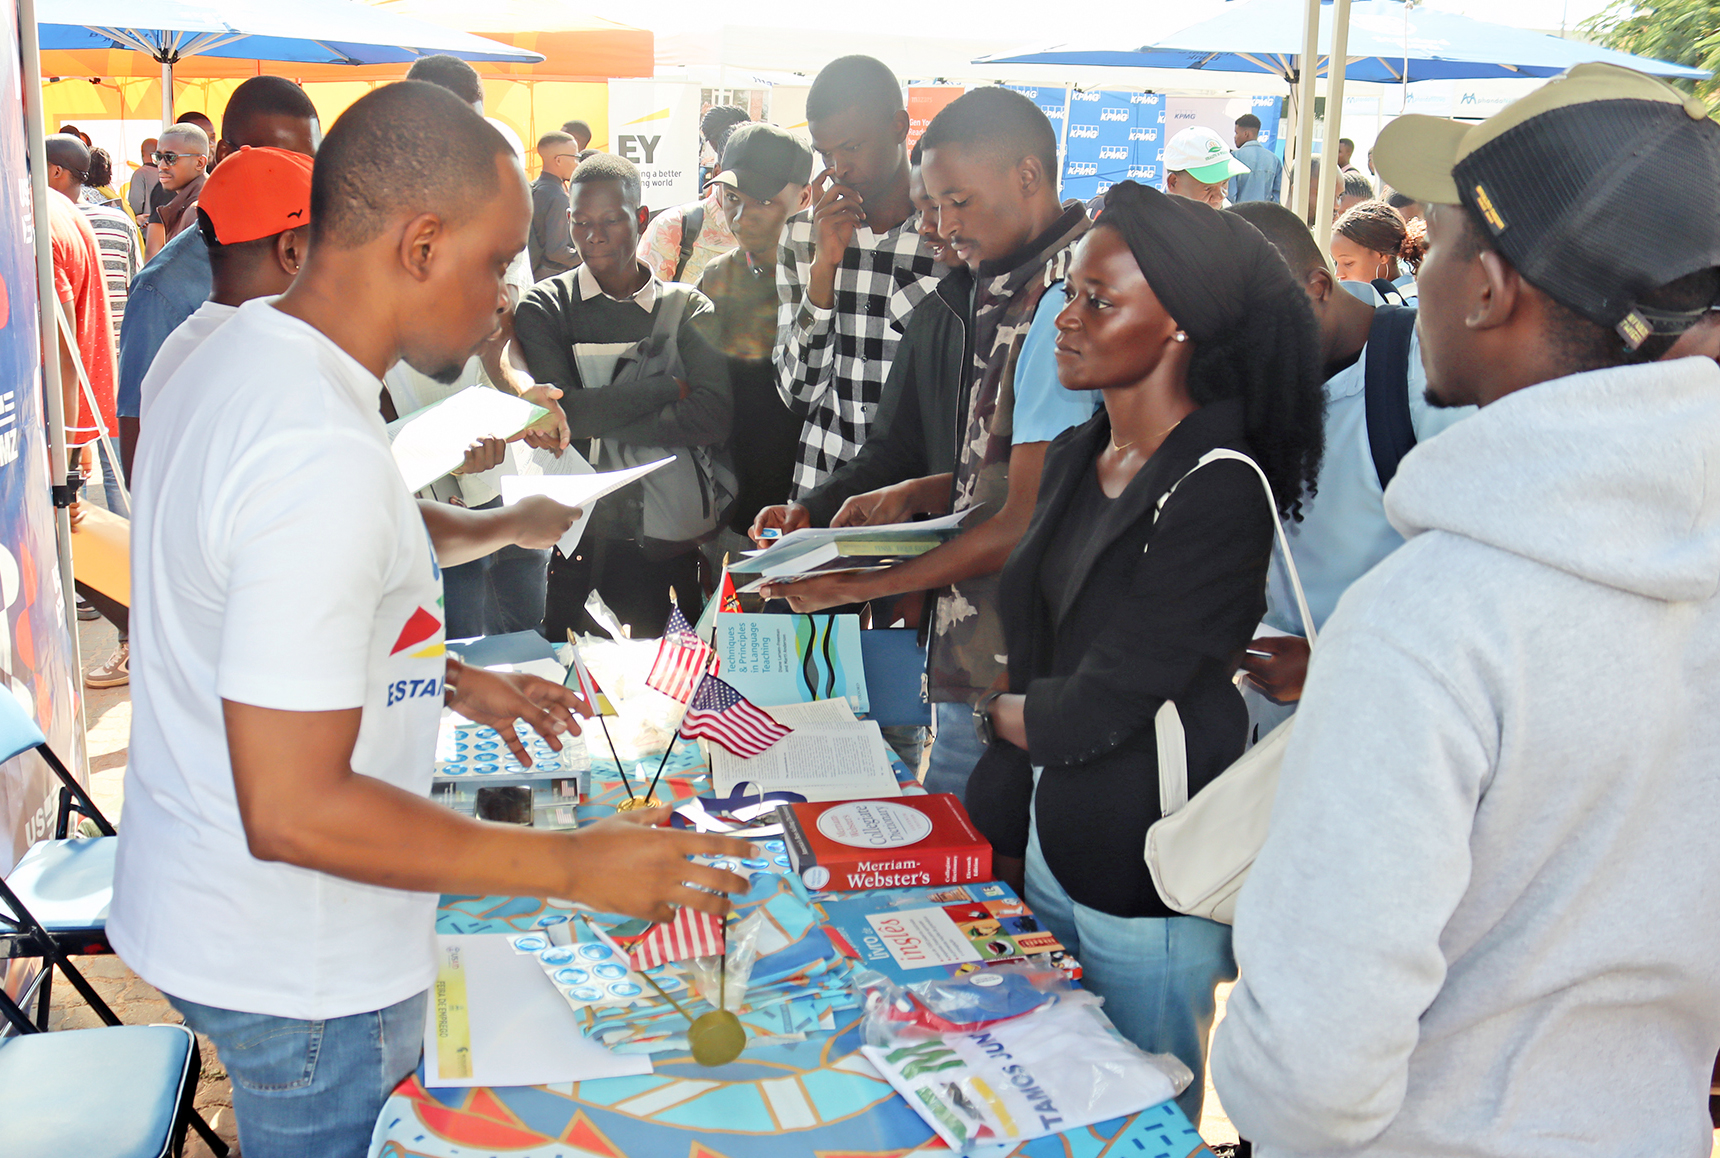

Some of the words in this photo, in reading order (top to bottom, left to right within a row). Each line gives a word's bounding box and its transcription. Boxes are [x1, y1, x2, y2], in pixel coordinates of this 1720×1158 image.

[1016, 88, 1038, 99] PMG
[1072, 91, 1100, 102] KPMG
[1131, 95, 1159, 105] KPMG
[1101, 112, 1130, 122] KPMG
[1069, 129, 1100, 139] KPMG
[1129, 131, 1158, 142] KPMG
[618, 135, 661, 164] EY
[1100, 149, 1129, 160] KPMG
[658, 170, 682, 178] better
[1068, 165, 1097, 176] KPMG
[1127, 168, 1156, 178] KPMG
[652, 179, 673, 187] world
[739, 622, 748, 666] Principles
[751, 622, 760, 666] Language
[762, 637, 771, 673] Teaching
[387, 675, 445, 708] ESTA
[856, 805, 888, 845] Collegiate
[876, 806, 905, 842] Dictionary
[857, 860, 921, 872] Merriam-
[847, 871, 931, 889] Webster's
[878, 918, 926, 961] inglês
[863, 936, 890, 961] livro
[451, 953, 459, 970] USAID
[437, 981, 446, 998] FEIRA
[438, 998, 447, 1006] DE
[438, 1007, 449, 1038] EMPREGO
